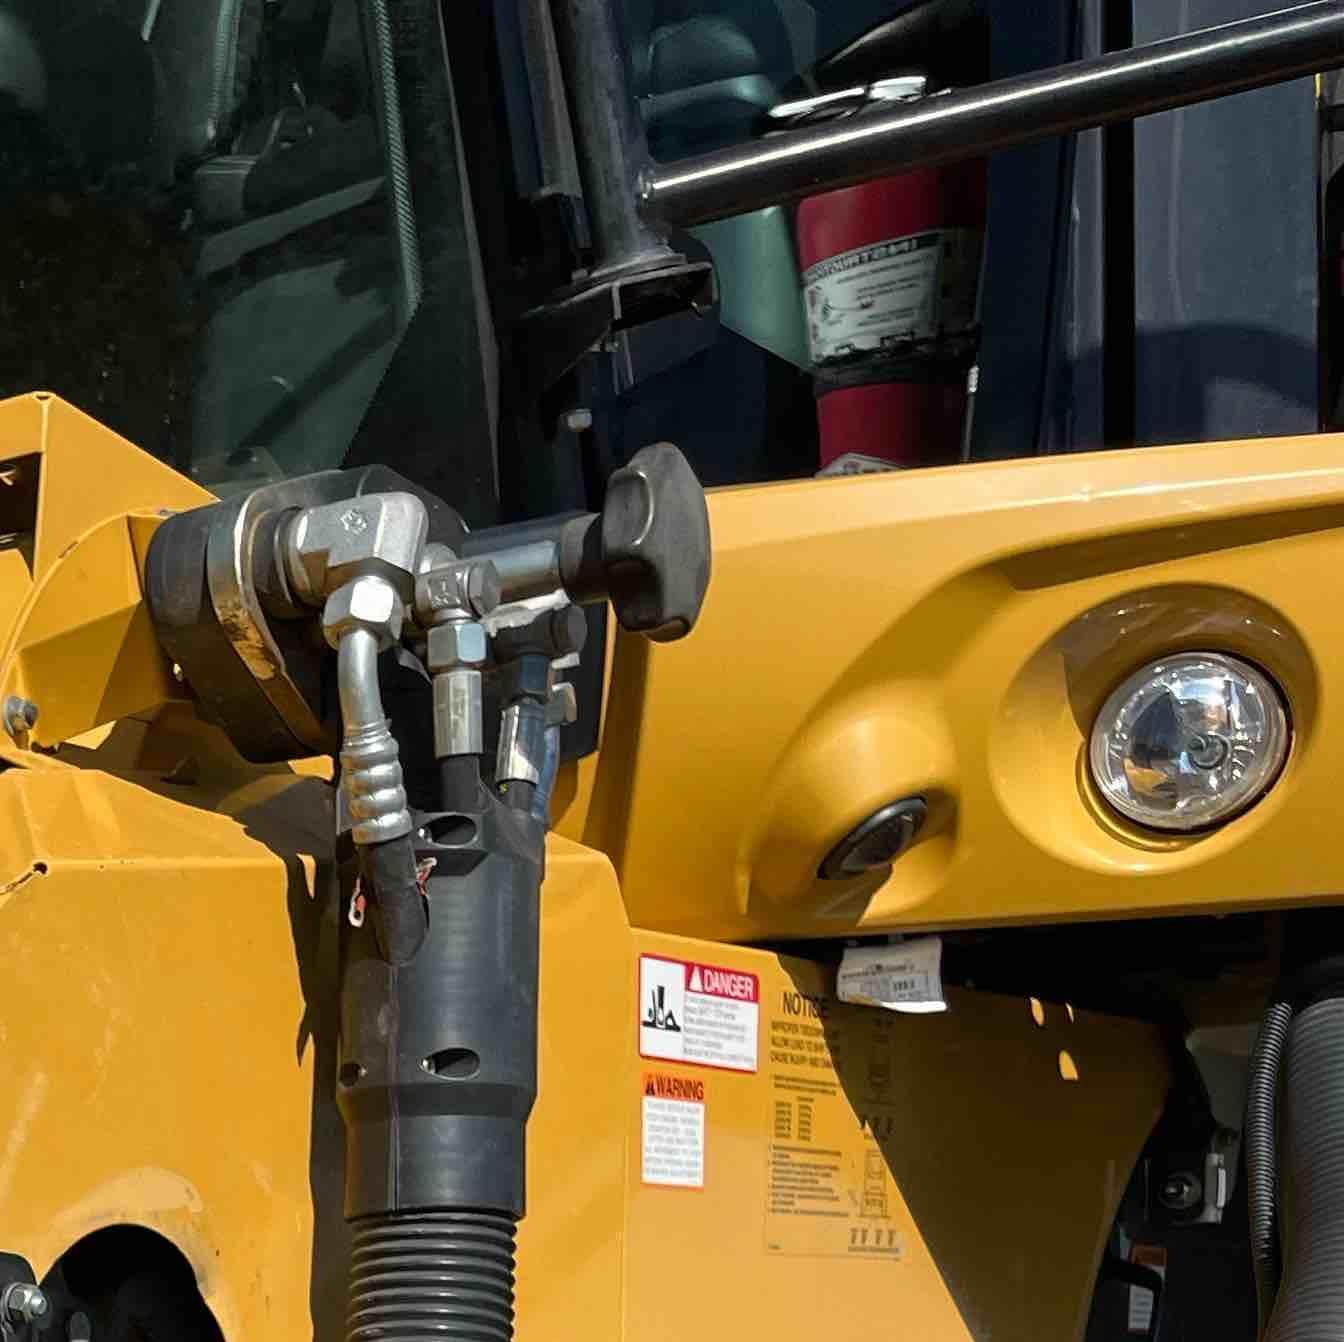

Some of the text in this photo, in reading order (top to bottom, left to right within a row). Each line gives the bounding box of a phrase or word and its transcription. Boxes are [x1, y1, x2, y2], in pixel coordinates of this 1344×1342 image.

[703, 969, 754, 1001] DANGER
[783, 991, 829, 1020] NOTICE
[655, 1072, 705, 1100] WARNING
